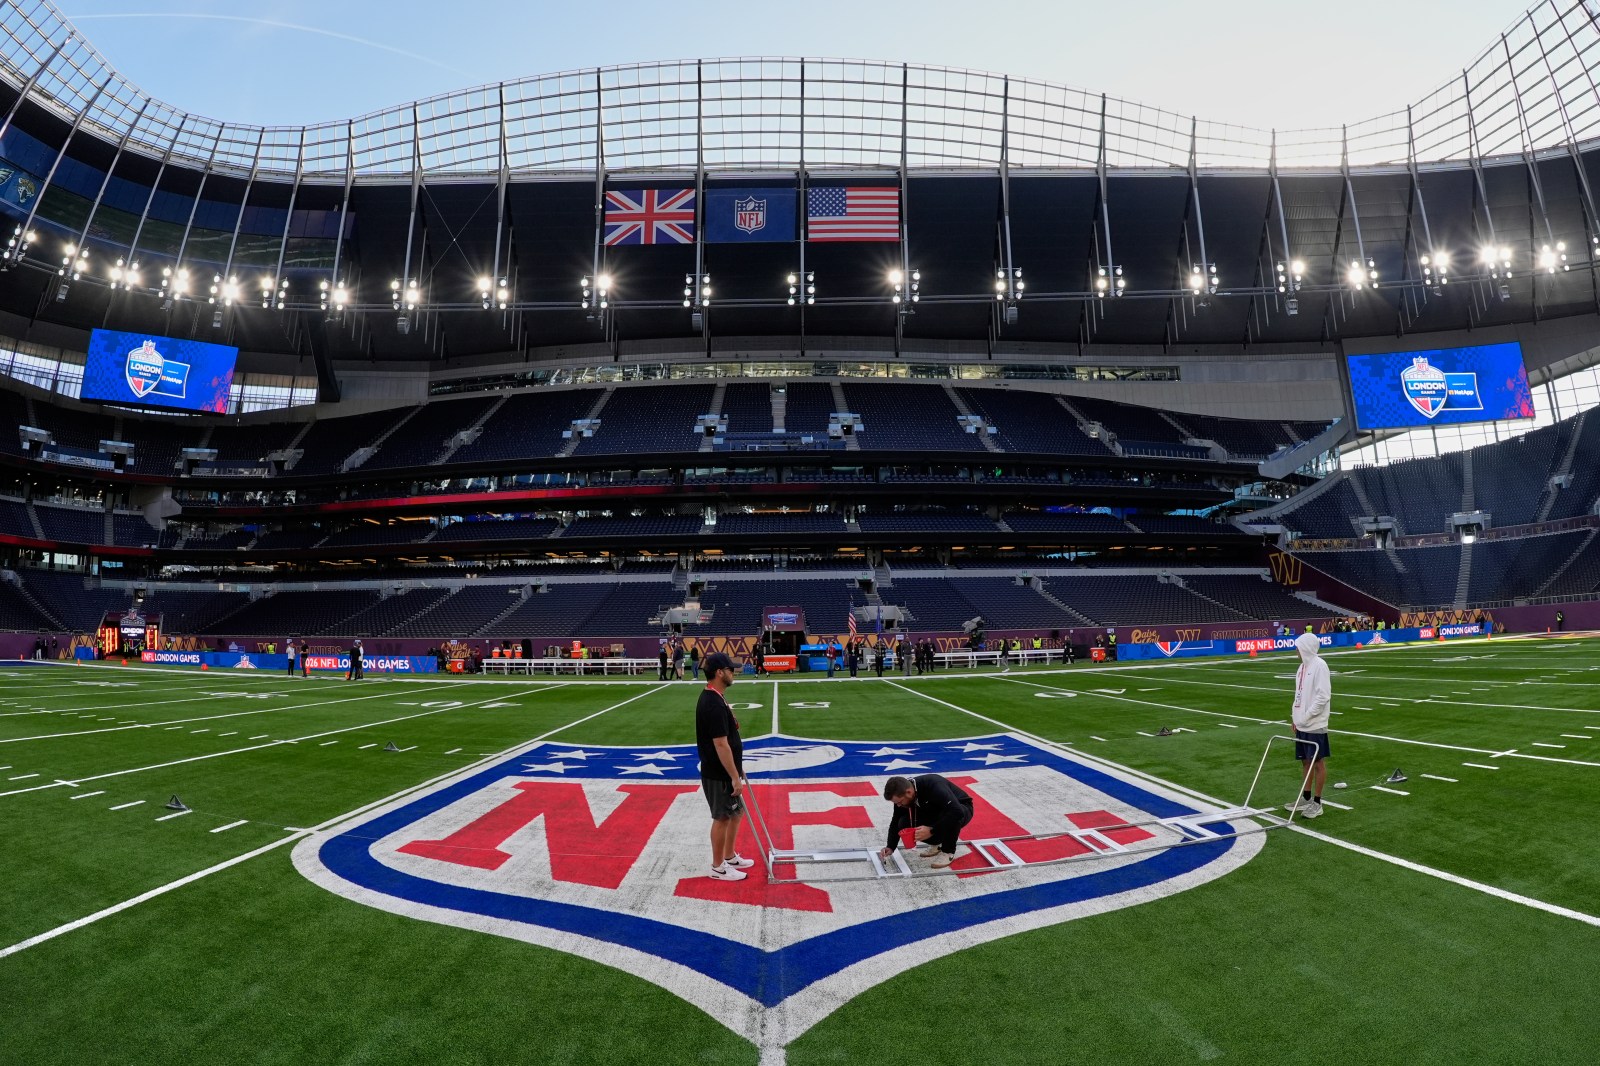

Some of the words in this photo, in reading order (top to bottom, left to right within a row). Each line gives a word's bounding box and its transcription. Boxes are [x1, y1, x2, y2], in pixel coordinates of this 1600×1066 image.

[738, 212, 762, 228] NFL
[131, 362, 161, 374] LONDON
[1408, 382, 1446, 390] LONDON
[1237, 641, 1255, 651] 2026
[1257, 640, 1273, 650] NFL
[1274, 638, 1297, 648] LOND
[1317, 636, 1332, 645] MES
[143, 653, 154, 661] NFL
[154, 653, 179, 662] LONDON
[180, 654, 200, 663] GAMES
[304, 658, 318, 668] 026
[320, 658, 336, 668] NFL
[338, 658, 376, 669] LOON
[378, 659, 410, 670] GAMES
[394, 775, 1156, 912] NFL
